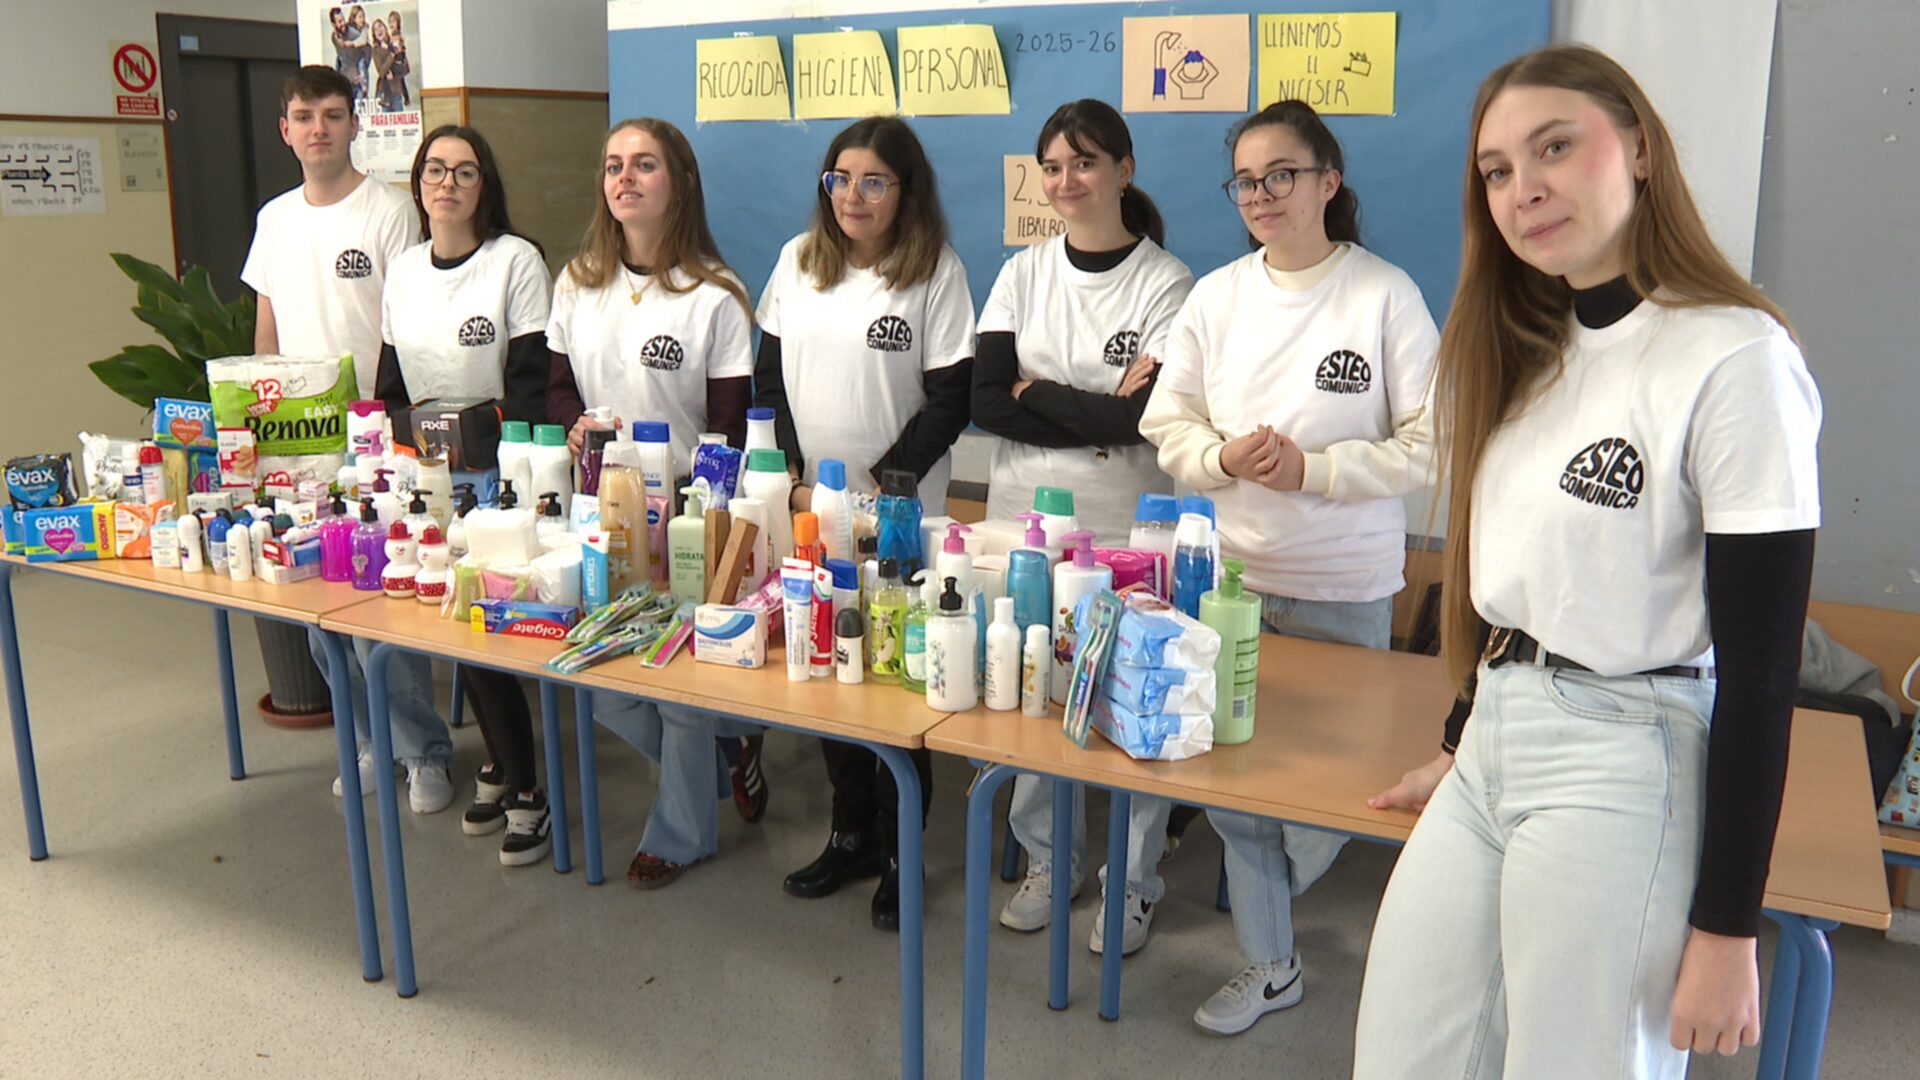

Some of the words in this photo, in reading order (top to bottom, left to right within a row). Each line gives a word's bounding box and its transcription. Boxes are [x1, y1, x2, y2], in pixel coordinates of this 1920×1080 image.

[1015, 31, 1116, 53] 2025-26
[1265, 21, 1342, 48] LLENEMOS
[699, 54, 787, 98] RECOGIDA
[799, 51, 884, 99] HIGIENE
[903, 46, 1007, 94] PERSONAL
[371, 114, 389, 126] PARA
[390, 112, 419, 125] FAMILIAS
[1018, 216, 1067, 237] FEBRERO
[336, 249, 372, 270] ESTEO
[336, 268, 372, 279] COMUNICA
[459, 316, 495, 337] ESTEO
[867, 315, 912, 344] ESTEO
[459, 335, 495, 347] COMUNICA
[641, 335, 684, 362] ESTEO
[867, 338, 911, 352] COMUNICA
[640, 357, 681, 371] COMUNICA
[1315, 349, 1371, 382] ESTEO
[255, 380, 281, 400] 12
[1315, 379, 1371, 394] COMUNICA
[164, 403, 211, 421] evax
[304, 404, 339, 418] EASY
[245, 415, 340, 441] Renova
[421, 420, 450, 431] AXE
[1566, 438, 1644, 494] ESTEO
[1559, 473, 1639, 509] COMUNICA
[35, 515, 80, 530] evax
[513, 622, 565, 638] Colgate
